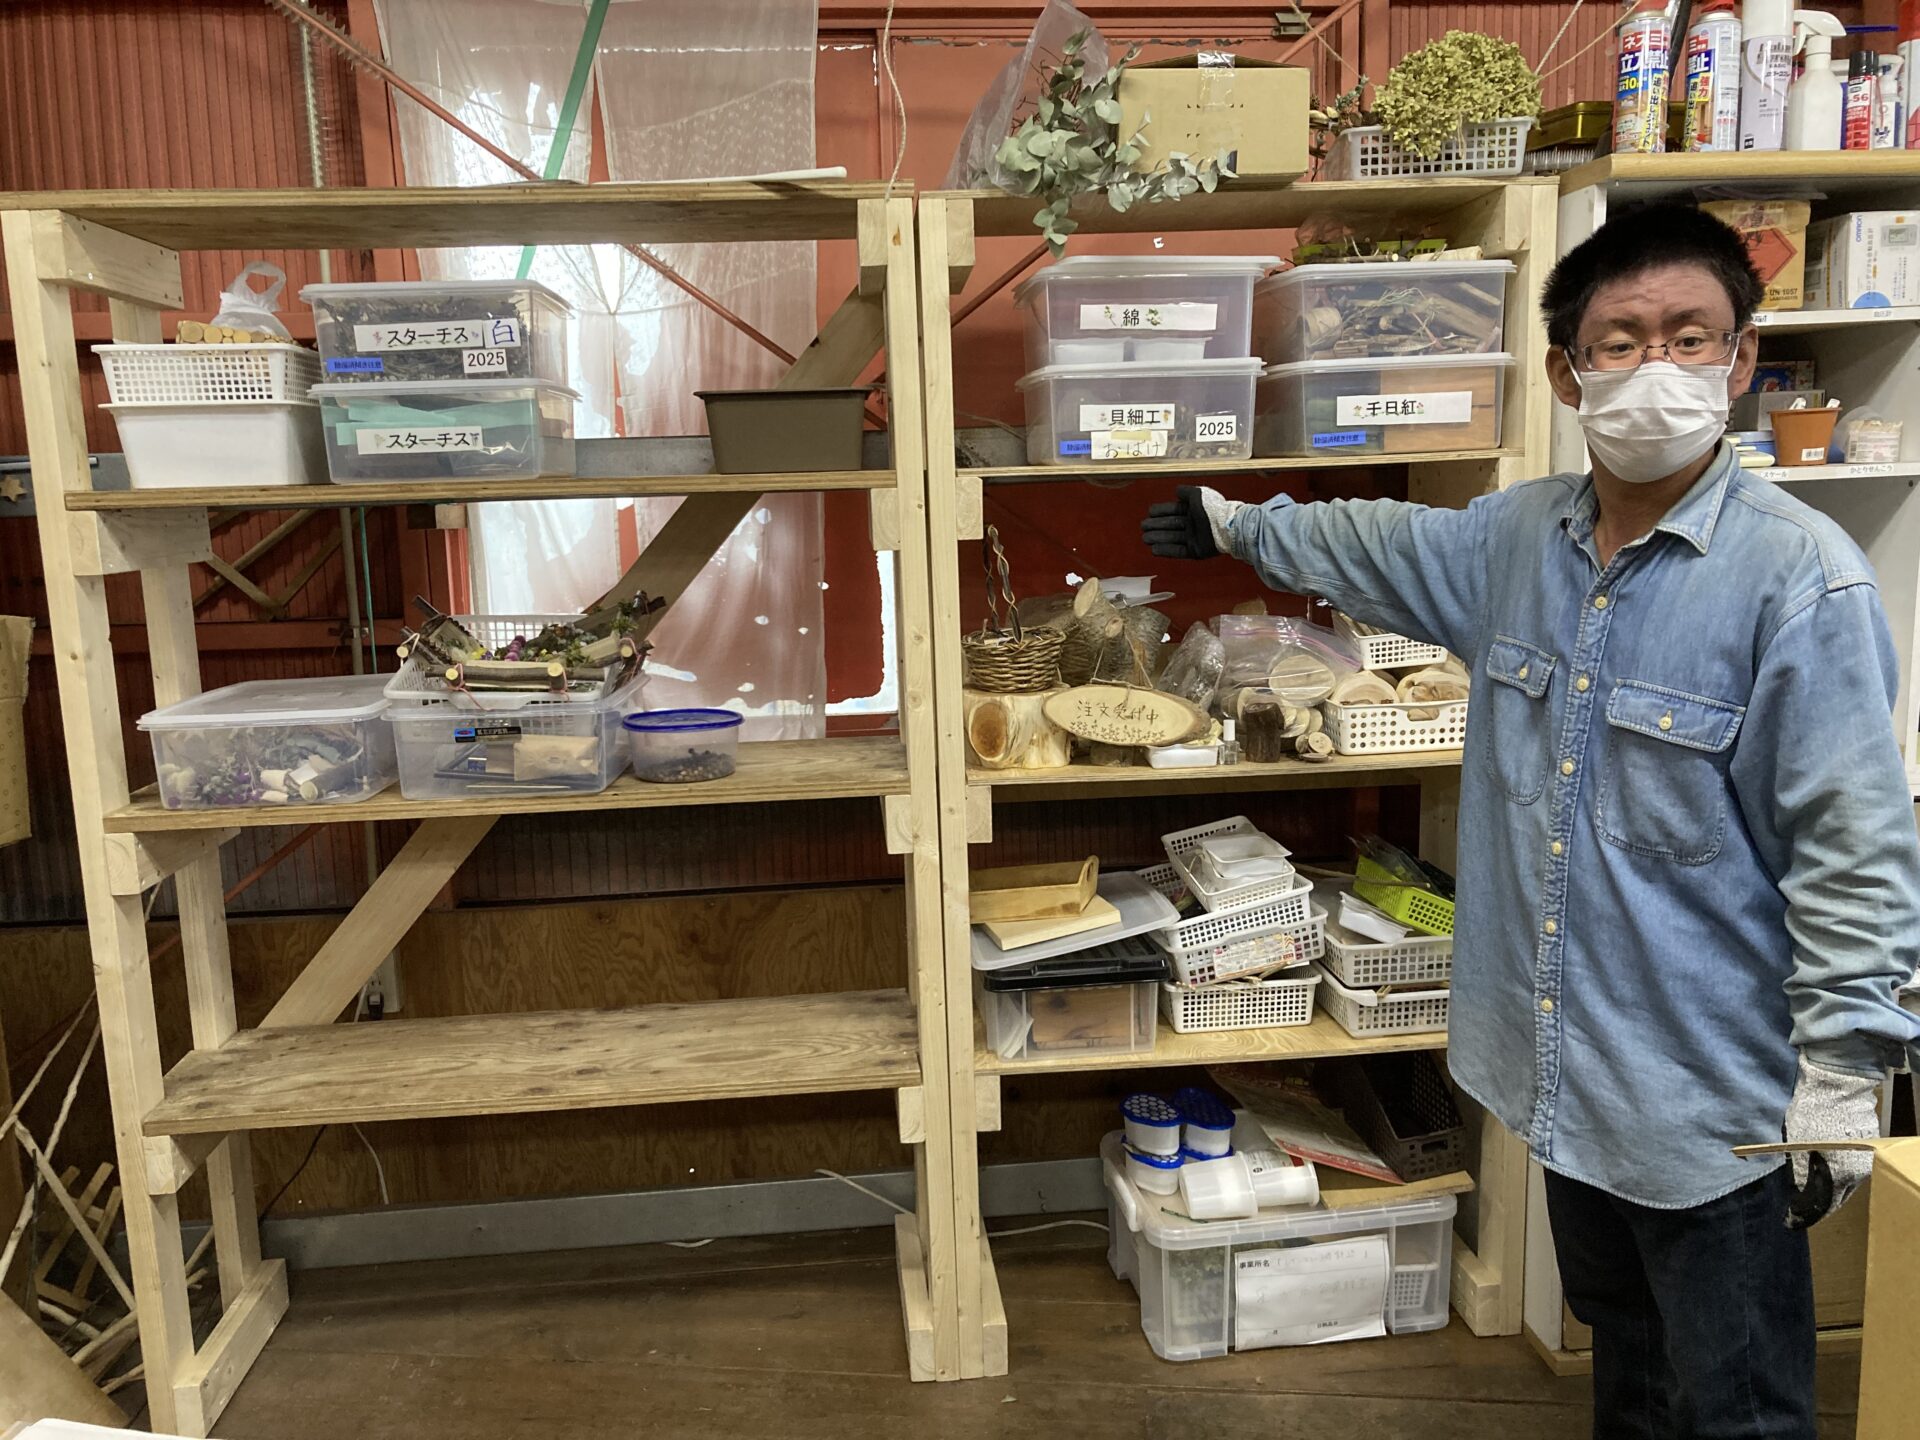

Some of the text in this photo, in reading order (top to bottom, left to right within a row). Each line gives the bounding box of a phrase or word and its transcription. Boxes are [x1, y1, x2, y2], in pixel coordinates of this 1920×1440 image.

[1122, 309, 1140, 327] 綿
[387, 327, 468, 346] スターチス
[492, 320, 515, 345] 白
[467, 352, 505, 367] 2025
[1366, 399, 1417, 416] 千日紅
[1108, 408, 1161, 426] 貝細工
[1199, 422, 1233, 436] 2025
[386, 432, 470, 448] スターチス
[1076, 700, 1159, 725] 注文受付中
